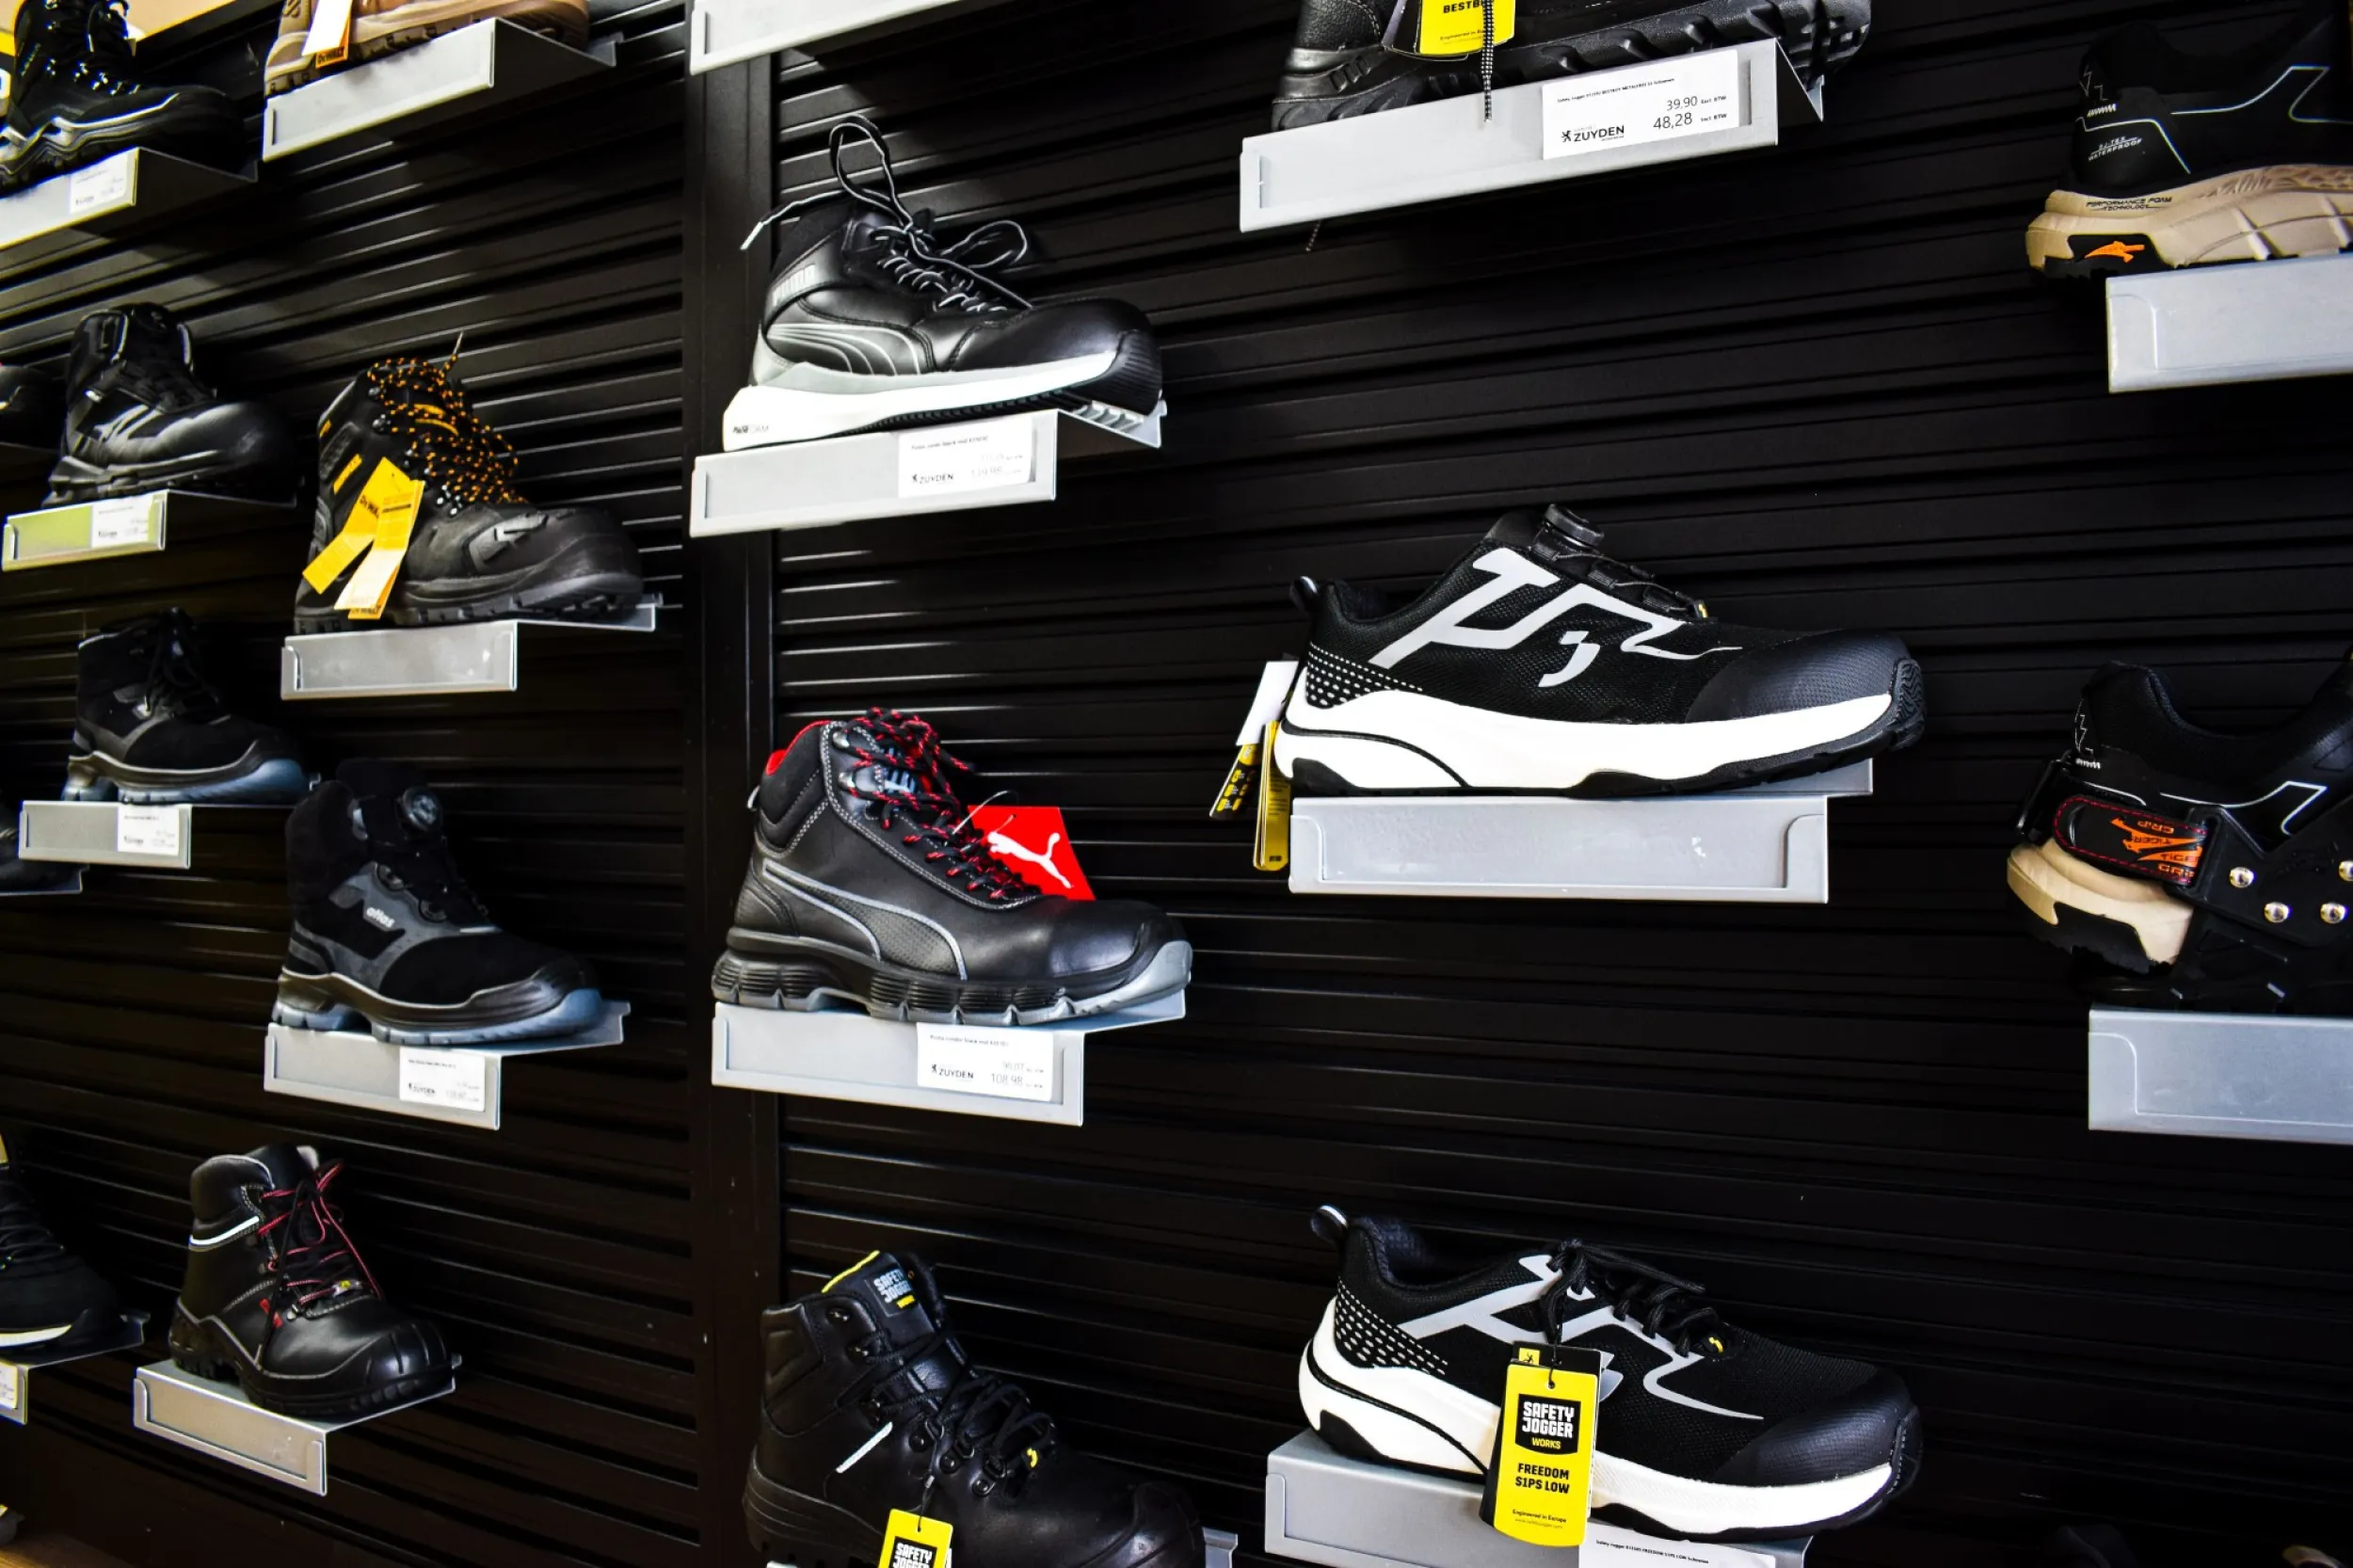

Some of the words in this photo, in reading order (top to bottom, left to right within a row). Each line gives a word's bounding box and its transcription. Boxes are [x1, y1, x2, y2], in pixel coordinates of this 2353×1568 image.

[1653, 112, 1693, 130] 48,28
[1574, 124, 1625, 142] ZUYDEN
[2088, 137, 2142, 161] WATERPROOF
[2086, 198, 2147, 207] PERFORMANCE
[919, 473, 954, 485] ZUYDEN
[938, 1068, 974, 1080] ZUYDEN
[991, 1073, 1023, 1086] 10898
[1523, 1400, 1575, 1423] SAFETY
[1522, 1416, 1573, 1439] JOGGER
[1531, 1437, 1561, 1449] WORKS
[1517, 1463, 1570, 1480] FREEDOM
[1515, 1476, 1543, 1490] S1PS
[1545, 1480, 1570, 1495] LOW
[896, 1542, 933, 1564] SAFETY
